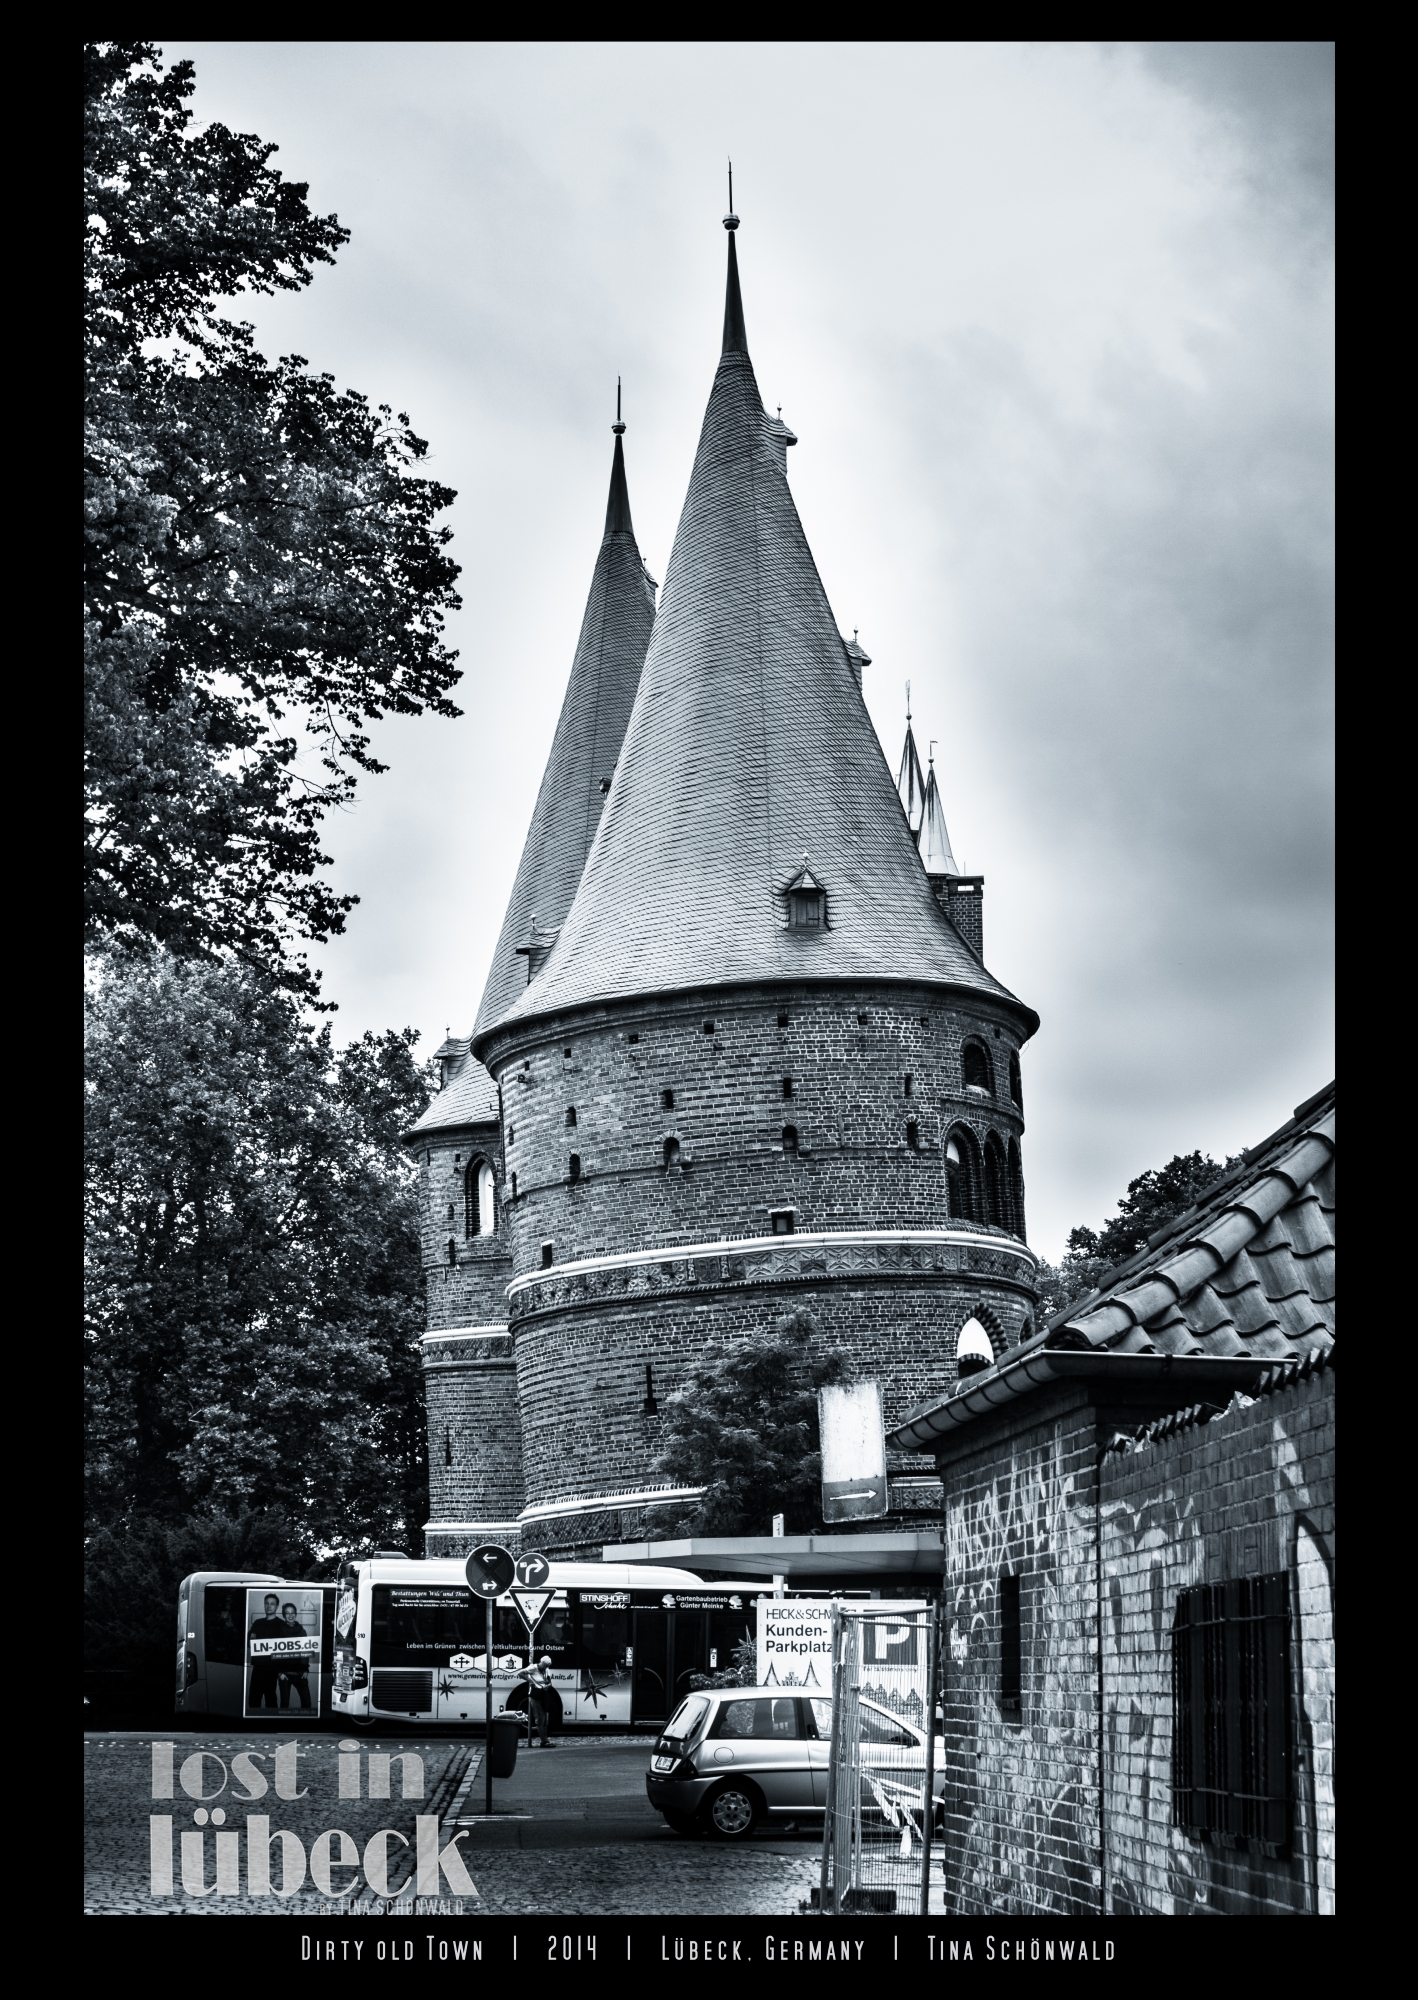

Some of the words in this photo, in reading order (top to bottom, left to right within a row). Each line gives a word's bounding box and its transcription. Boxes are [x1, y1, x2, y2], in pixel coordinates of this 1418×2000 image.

[581, 1594, 629, 1602] STINSHOFF
[675, 1594, 728, 1603] Gartenbaubetrieb
[766, 1624, 828, 1637] Kunden-
[874, 1616, 910, 1660] P
[253, 1640, 319, 1653] LN-JOBS.de
[766, 1640, 833, 1656] Parkplatz
